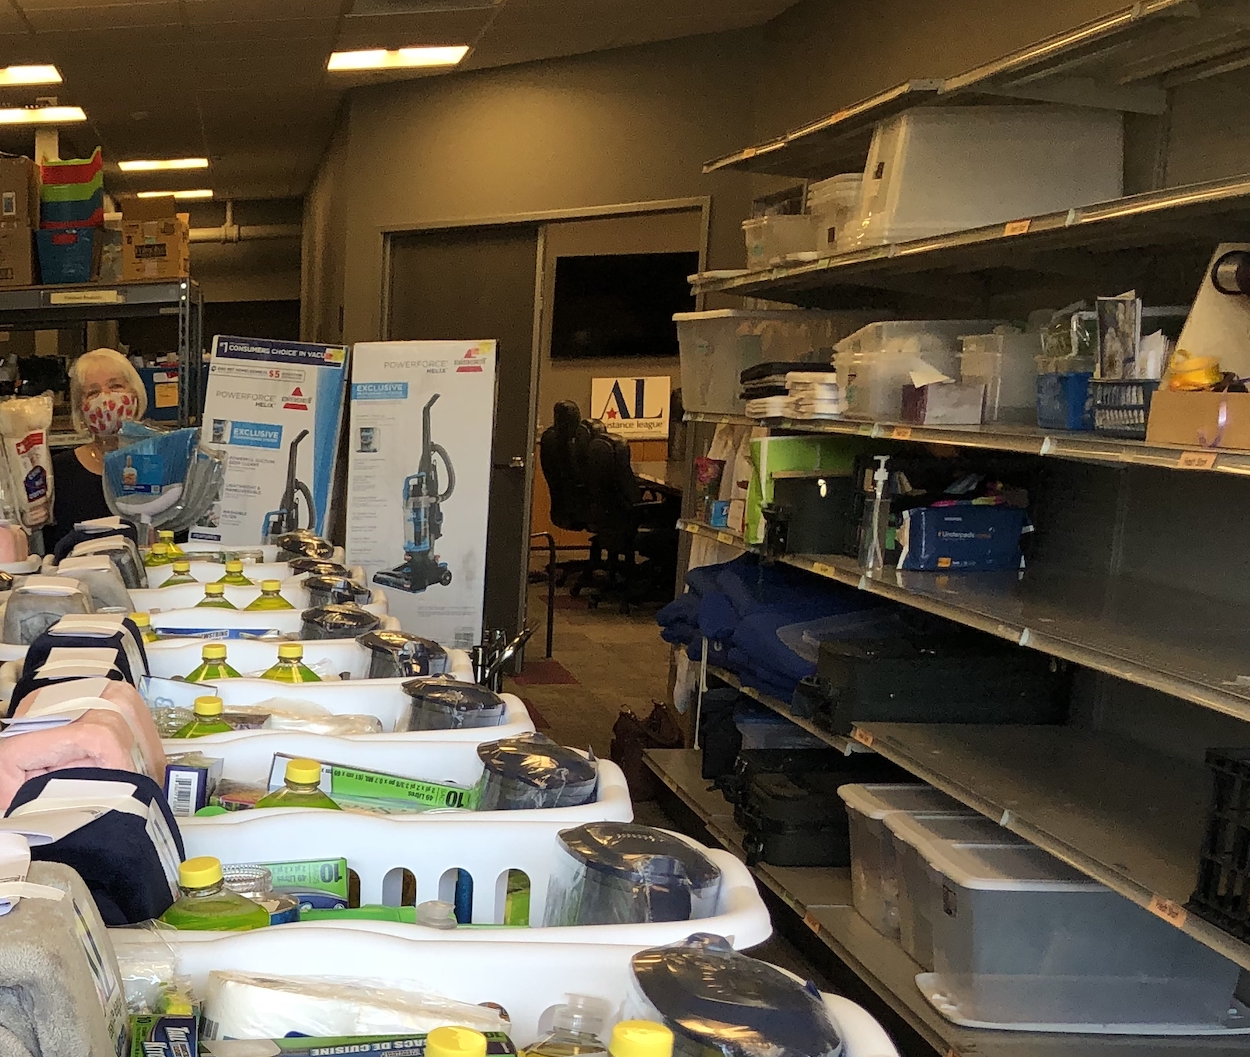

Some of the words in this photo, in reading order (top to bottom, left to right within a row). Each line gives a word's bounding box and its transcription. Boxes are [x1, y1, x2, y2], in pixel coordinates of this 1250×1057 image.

[228, 345, 270, 355] CONSUMERS
[271, 348, 296, 357] CHOICE
[384, 360, 448, 369] POWERFORCE
[268, 370, 281, 378] $5
[356, 384, 403, 392] EXCLUSIVE
[216, 391, 276, 402] POWERFORCE
[591, 379, 663, 419] AL
[233, 428, 279, 439] EXCLUSIVE
[407, 790, 424, 800] Litres
[445, 790, 465, 808] 10
[320, 863, 342, 883] 10
[311, 1043, 370, 1057] CUISINE
[373, 1041, 390, 1052] DE
